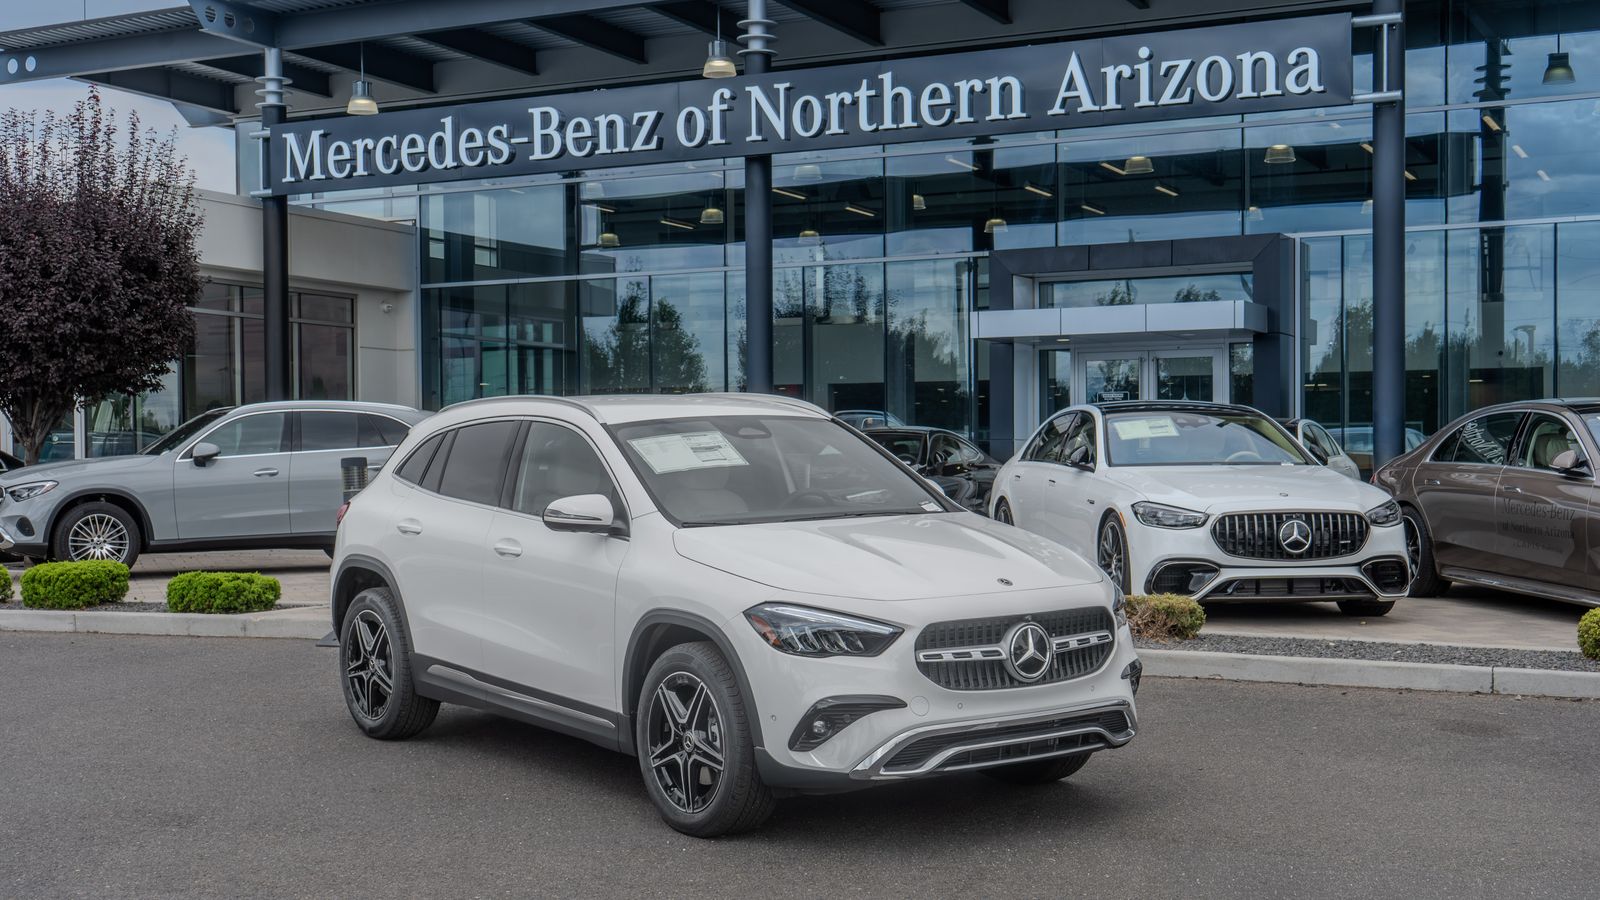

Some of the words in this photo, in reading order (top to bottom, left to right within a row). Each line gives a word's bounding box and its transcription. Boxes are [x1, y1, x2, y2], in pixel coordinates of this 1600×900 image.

[282, 106, 660, 183] Mercedes-Benz
[676, 88, 734, 148] of
[745, 71, 1027, 143] Northern
[1047, 46, 1324, 115] Arizona
[1503, 498, 1576, 520] Mercedes-Benz
